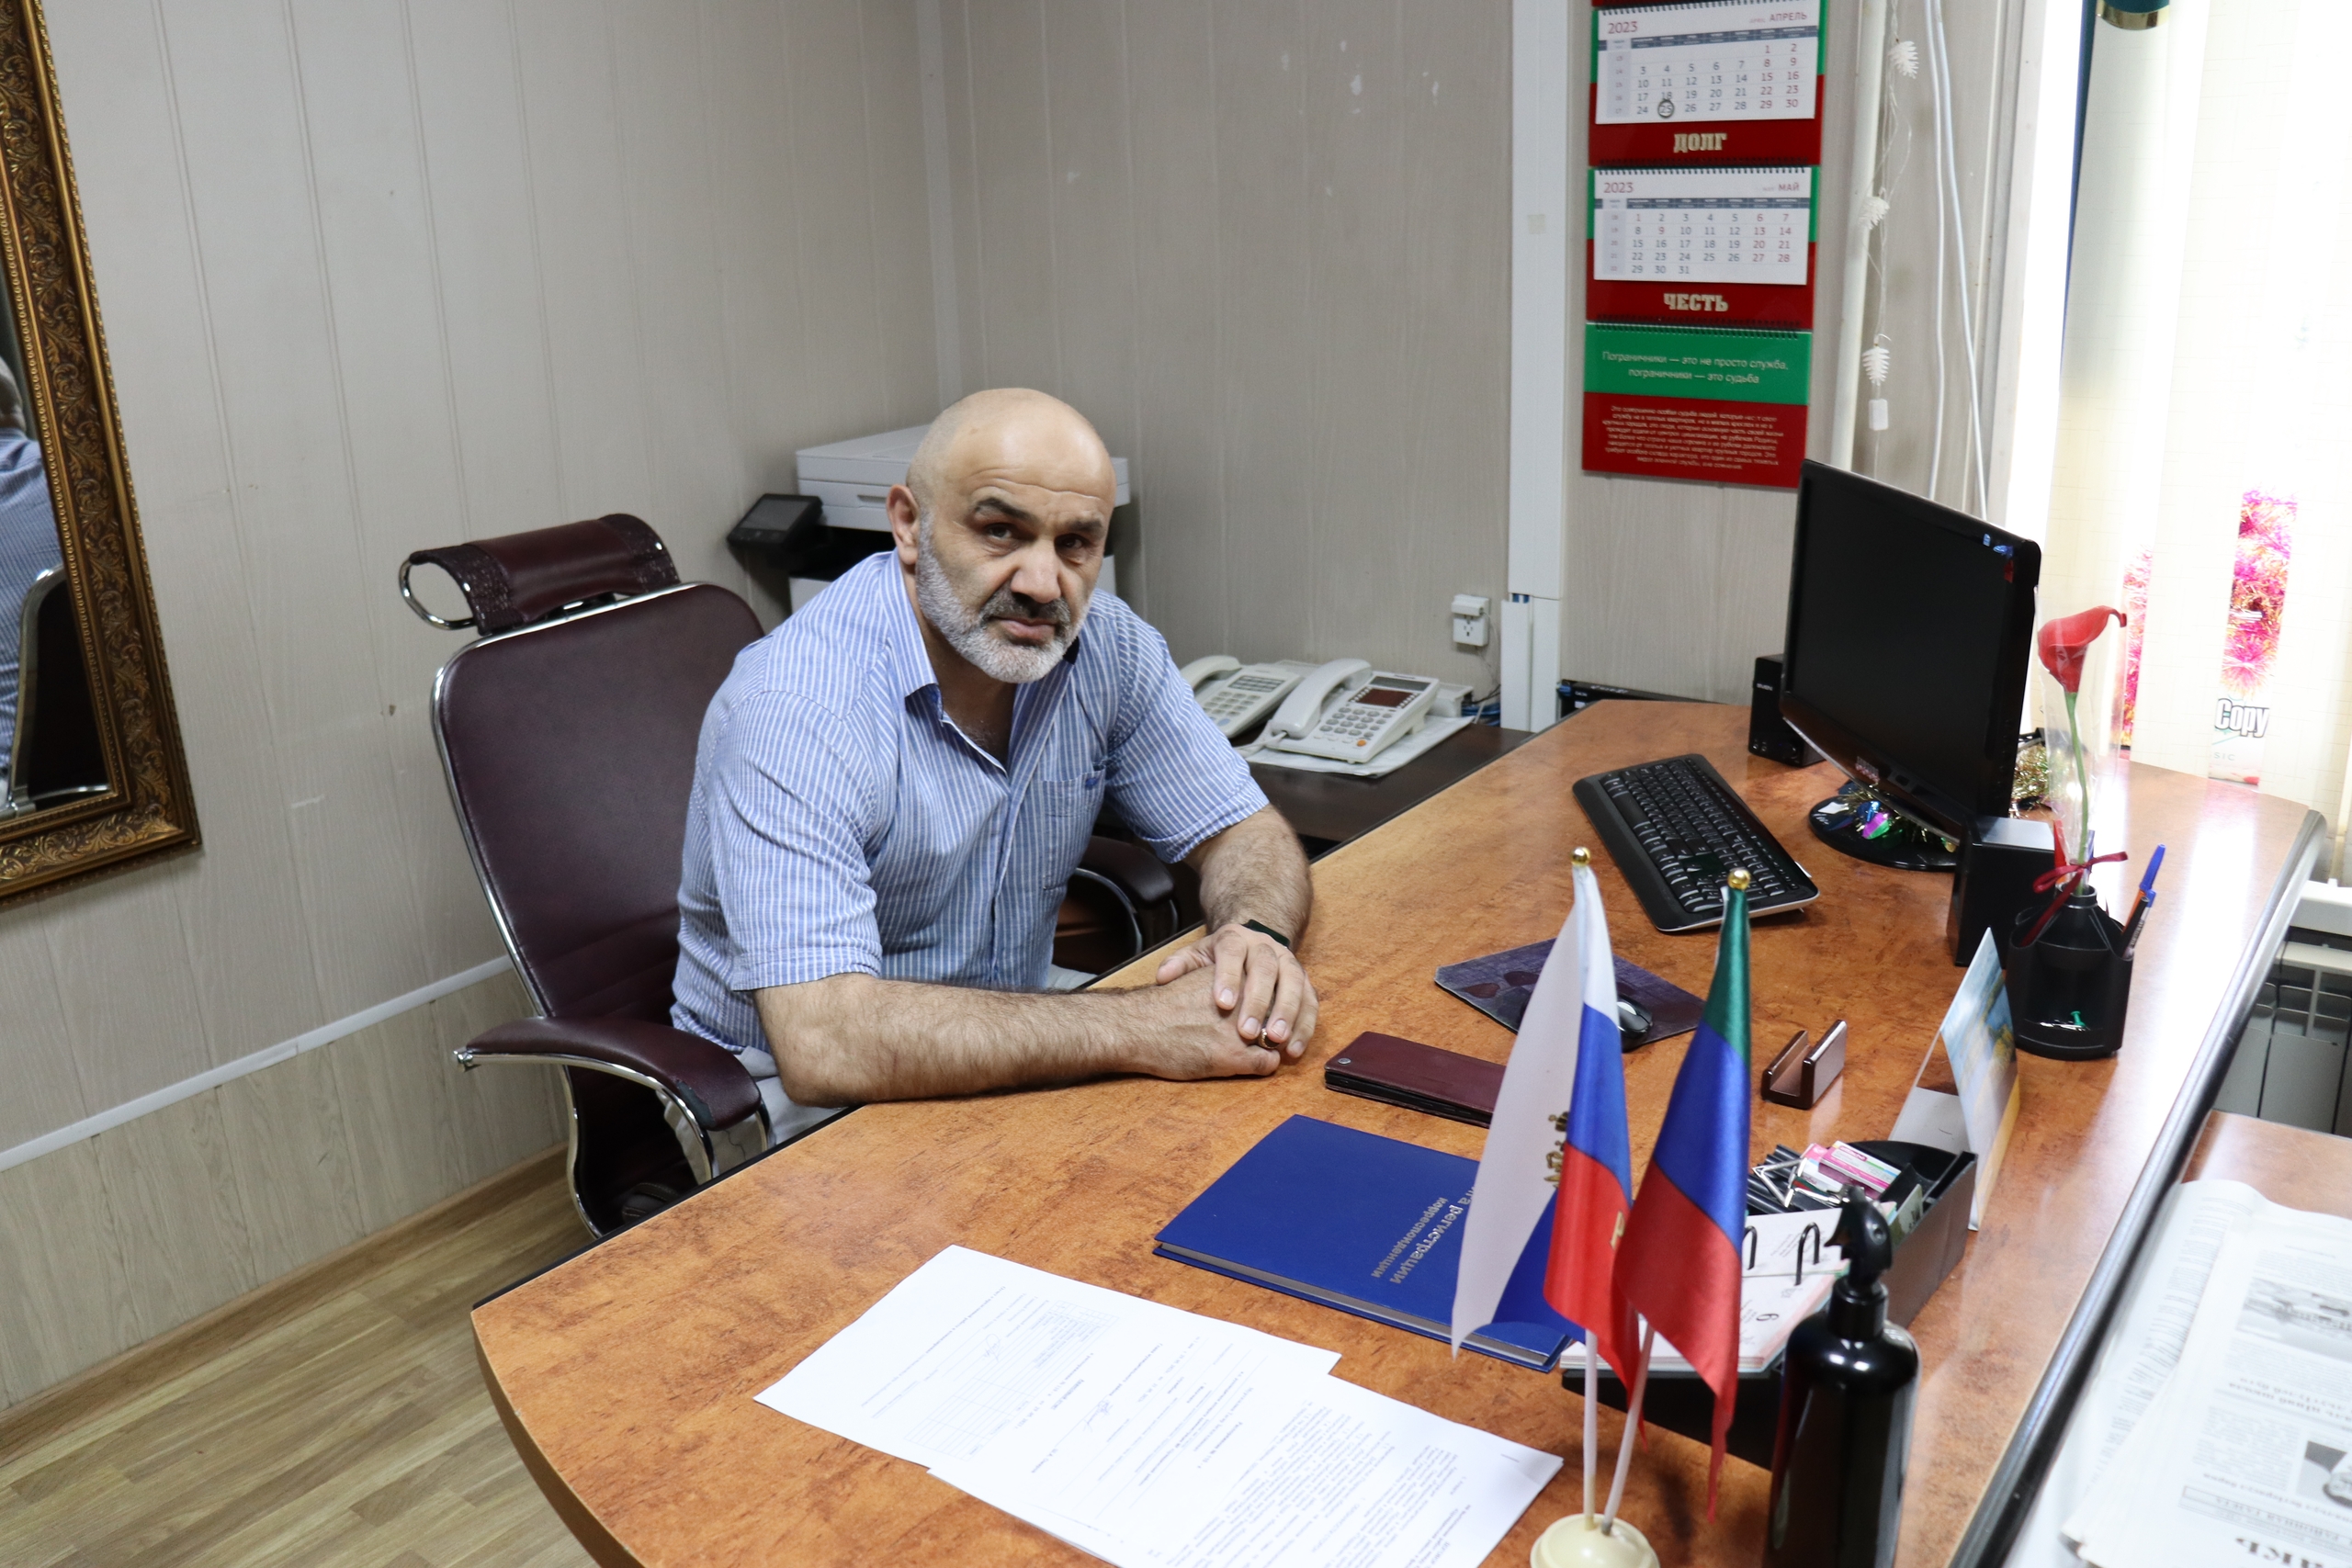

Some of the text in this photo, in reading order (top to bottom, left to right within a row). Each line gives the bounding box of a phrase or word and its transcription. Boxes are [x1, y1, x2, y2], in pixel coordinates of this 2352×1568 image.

[1770, 12, 1807, 23] АПРЕЛЬ
[1608, 21, 1638, 34] 2023
[1765, 44, 1770, 54] 1
[1791, 42, 1797, 52] 2
[1640, 65, 1646, 75] 3
[1664, 64, 1670, 73] 4
[1689, 62, 1695, 73] 5
[1713, 62, 1720, 71] 6
[1738, 60, 1746, 69] 7
[1763, 58, 1770, 68] 8
[1790, 57, 1797, 67] 9
[1637, 79, 1650, 89] 10
[1661, 78, 1673, 87] 11
[1686, 76, 1698, 86] 12
[1711, 74, 1723, 85] 13
[1736, 73, 1747, 84] 14
[1761, 72, 1773, 82] 15
[1787, 71, 1800, 81] 16
[1637, 92, 1649, 102] 17
[1686, 89, 1698, 99] 19
[1709, 88, 1723, 98] 20
[1735, 87, 1747, 97] 21
[1760, 85, 1772, 96] 22
[1786, 85, 1799, 95] 23
[1636, 106, 1649, 115] 24
[1684, 103, 1697, 113] 26
[1709, 102, 1722, 112] 27
[1734, 101, 1747, 110] 28
[1759, 99, 1773, 109] 29
[1786, 98, 1799, 108] 30
[1673, 133, 1727, 153] ДОЛГ
[1603, 182, 1634, 194] 2023
[1778, 182, 1800, 192] МАЙ
[1635, 213, 1642, 222] 1
[1658, 213, 1665, 222] 2
[1683, 213, 1689, 222] 3
[1707, 213, 1713, 221] 4
[1732, 213, 1738, 222] 5
[1756, 213, 1764, 222] 6
[1782, 213, 1790, 222] 7
[1634, 226, 1642, 235] 8
[1658, 226, 1665, 235] 9
[1680, 226, 1692, 235] 10
[1704, 226, 1715, 236] 11
[1729, 226, 1741, 236] 12
[1754, 226, 1766, 236] 13
[1779, 227, 1792, 236] 14
[1633, 239, 1644, 248] 15
[1656, 239, 1668, 248] 16
[1679, 239, 1691, 249] 17
[1704, 239, 1716, 249] 18
[1728, 240, 1741, 249] 19
[1752, 240, 1766, 249] 20
[1778, 240, 1791, 250] 21
[1631, 252, 1644, 261] 22
[1655, 252, 1667, 261] 23
[1679, 252, 1691, 262] 24
[1702, 253, 1715, 262] 25
[1727, 253, 1740, 263] 26
[1752, 253, 1765, 263] 27
[1777, 254, 1791, 263] 28
[1631, 265, 1644, 274] 29
[1655, 265, 1667, 274] 30
[1679, 265, 1690, 275] 31
[1663, 293, 1729, 312] ЧЕСТЬ
[1714, 358, 1747, 367] просто
[2214, 697, 2269, 739] Copy
[1371, 1197, 1449, 1278] корреспонденции
[1389, 1204, 1464, 1284] регистрации
